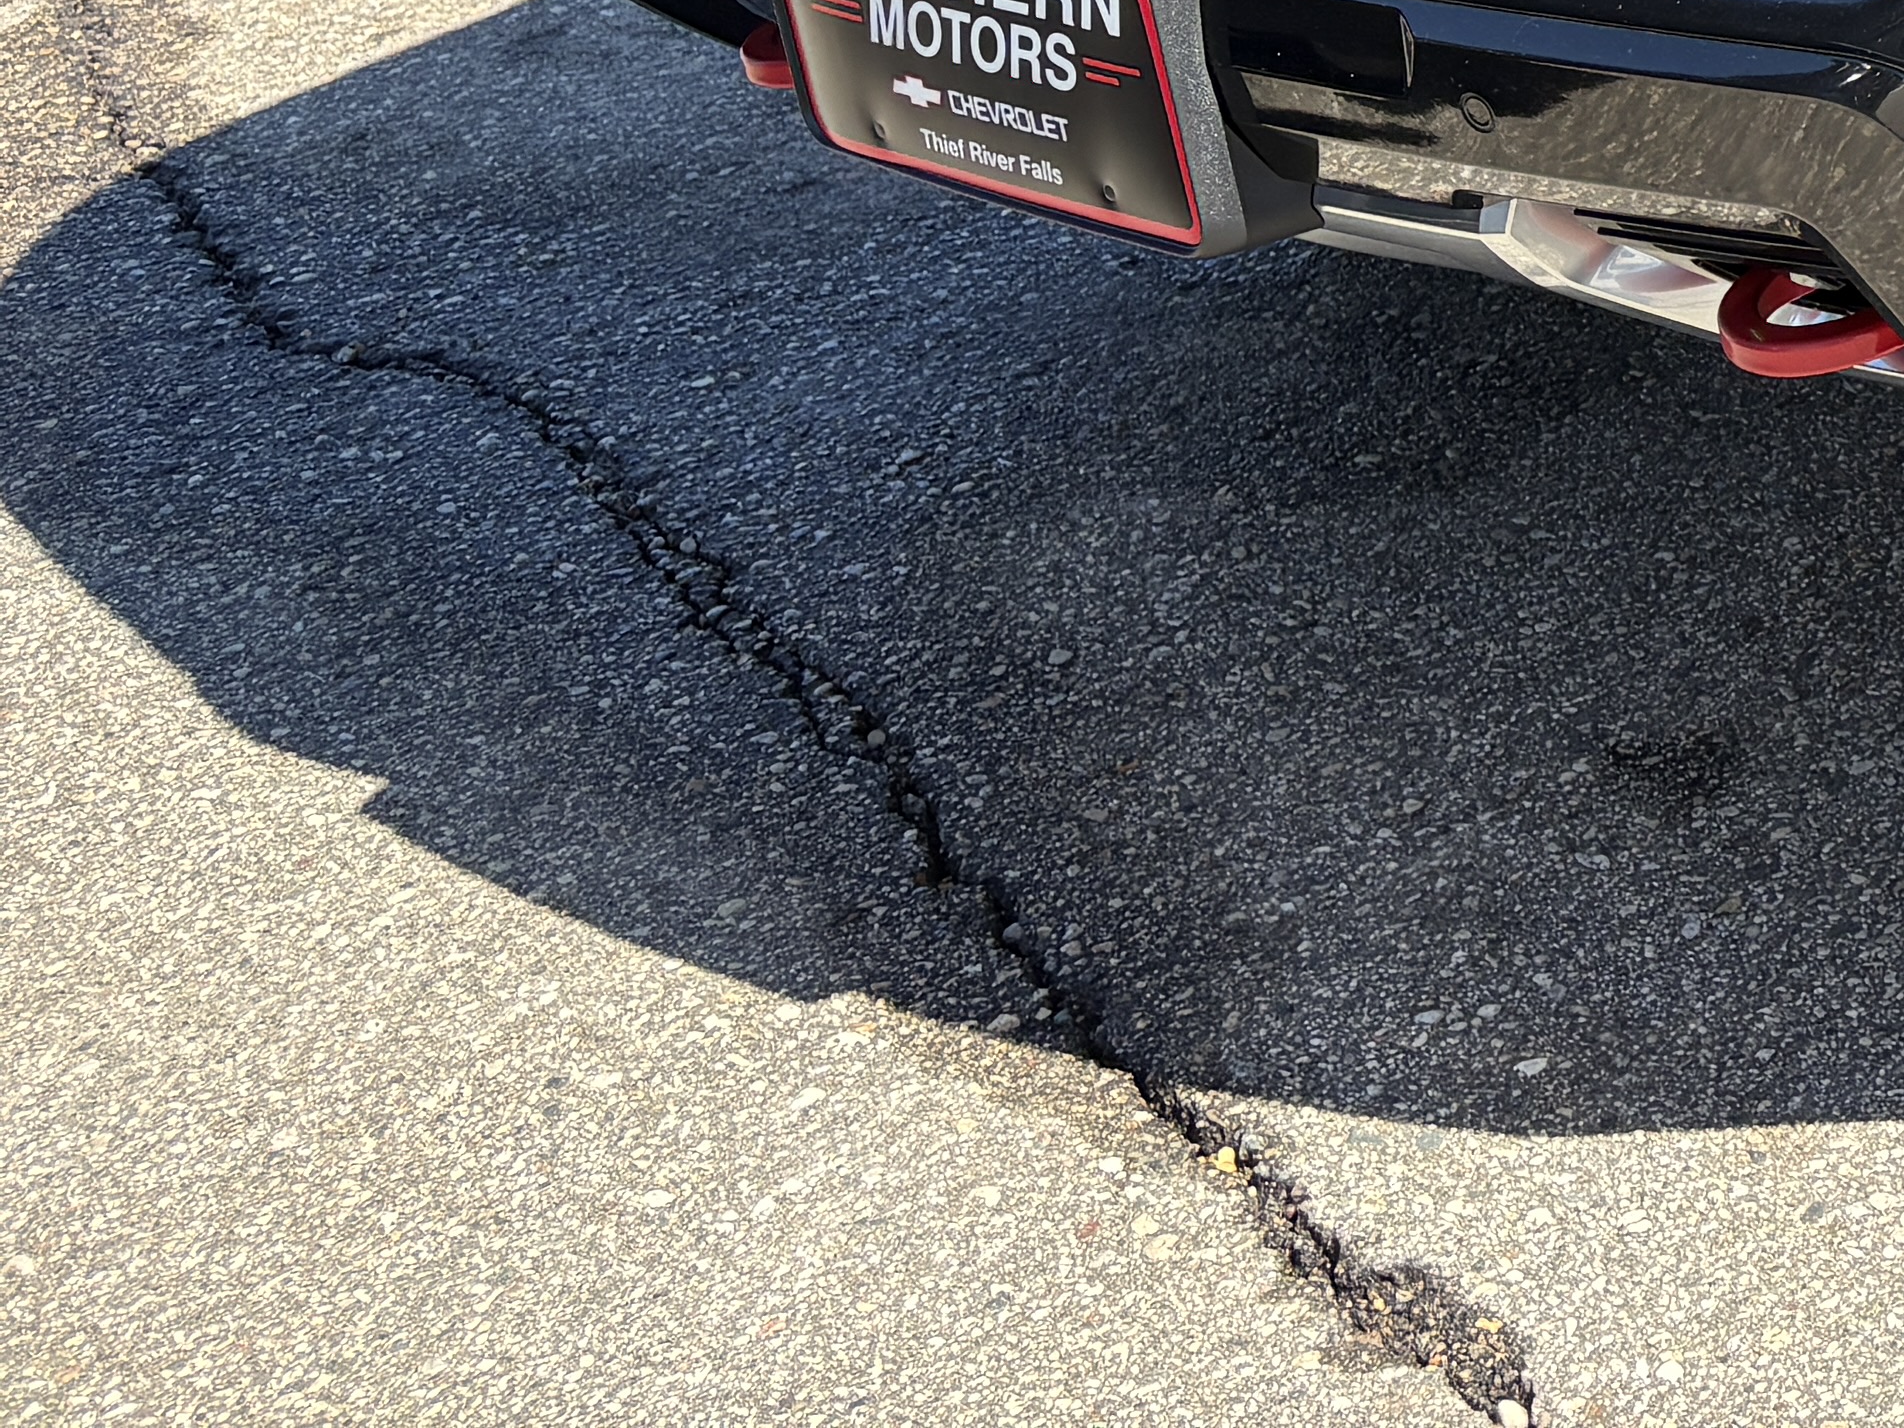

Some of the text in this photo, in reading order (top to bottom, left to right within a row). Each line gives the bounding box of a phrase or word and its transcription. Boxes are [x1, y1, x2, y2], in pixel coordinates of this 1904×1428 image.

[947, 89, 1069, 142] CHEVROLET
[919, 128, 1064, 186] Thief River Falls
